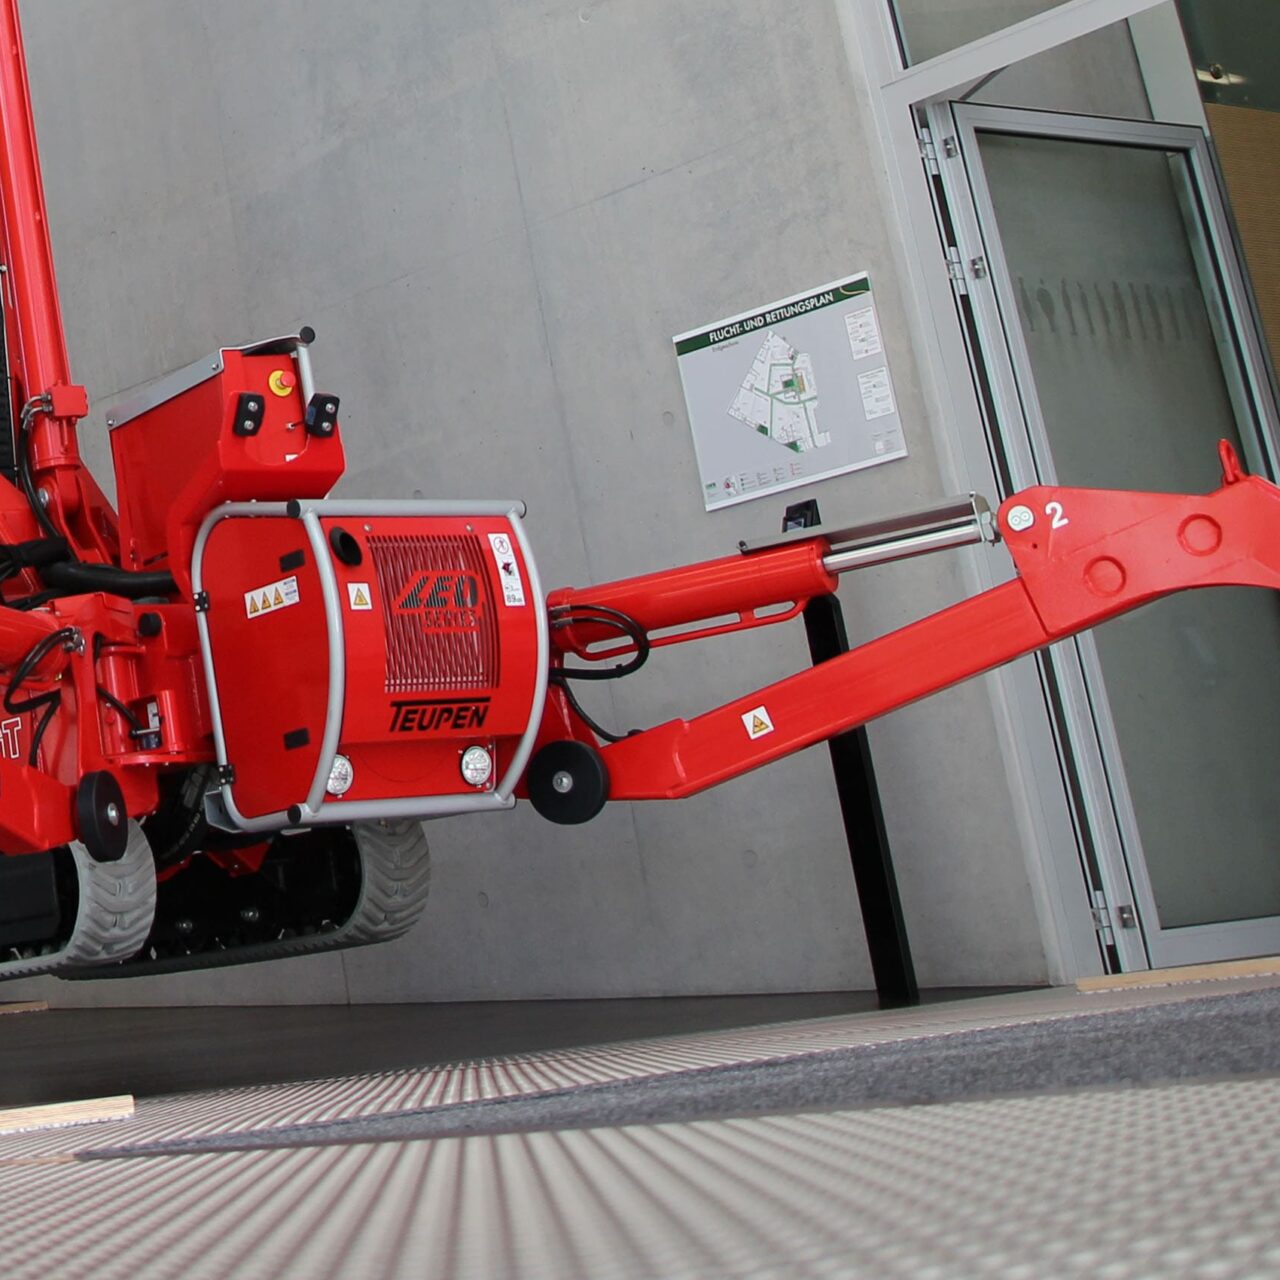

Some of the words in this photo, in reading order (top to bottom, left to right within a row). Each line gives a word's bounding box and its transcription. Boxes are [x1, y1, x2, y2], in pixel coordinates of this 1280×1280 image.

[709, 325, 743, 343] FLUCHT-
[743, 316, 764, 331] UND
[765, 291, 834, 324] RETTUNGSPLAN
[1045, 501, 1069, 529] 2
[389, 696, 492, 733] TEUPEN
